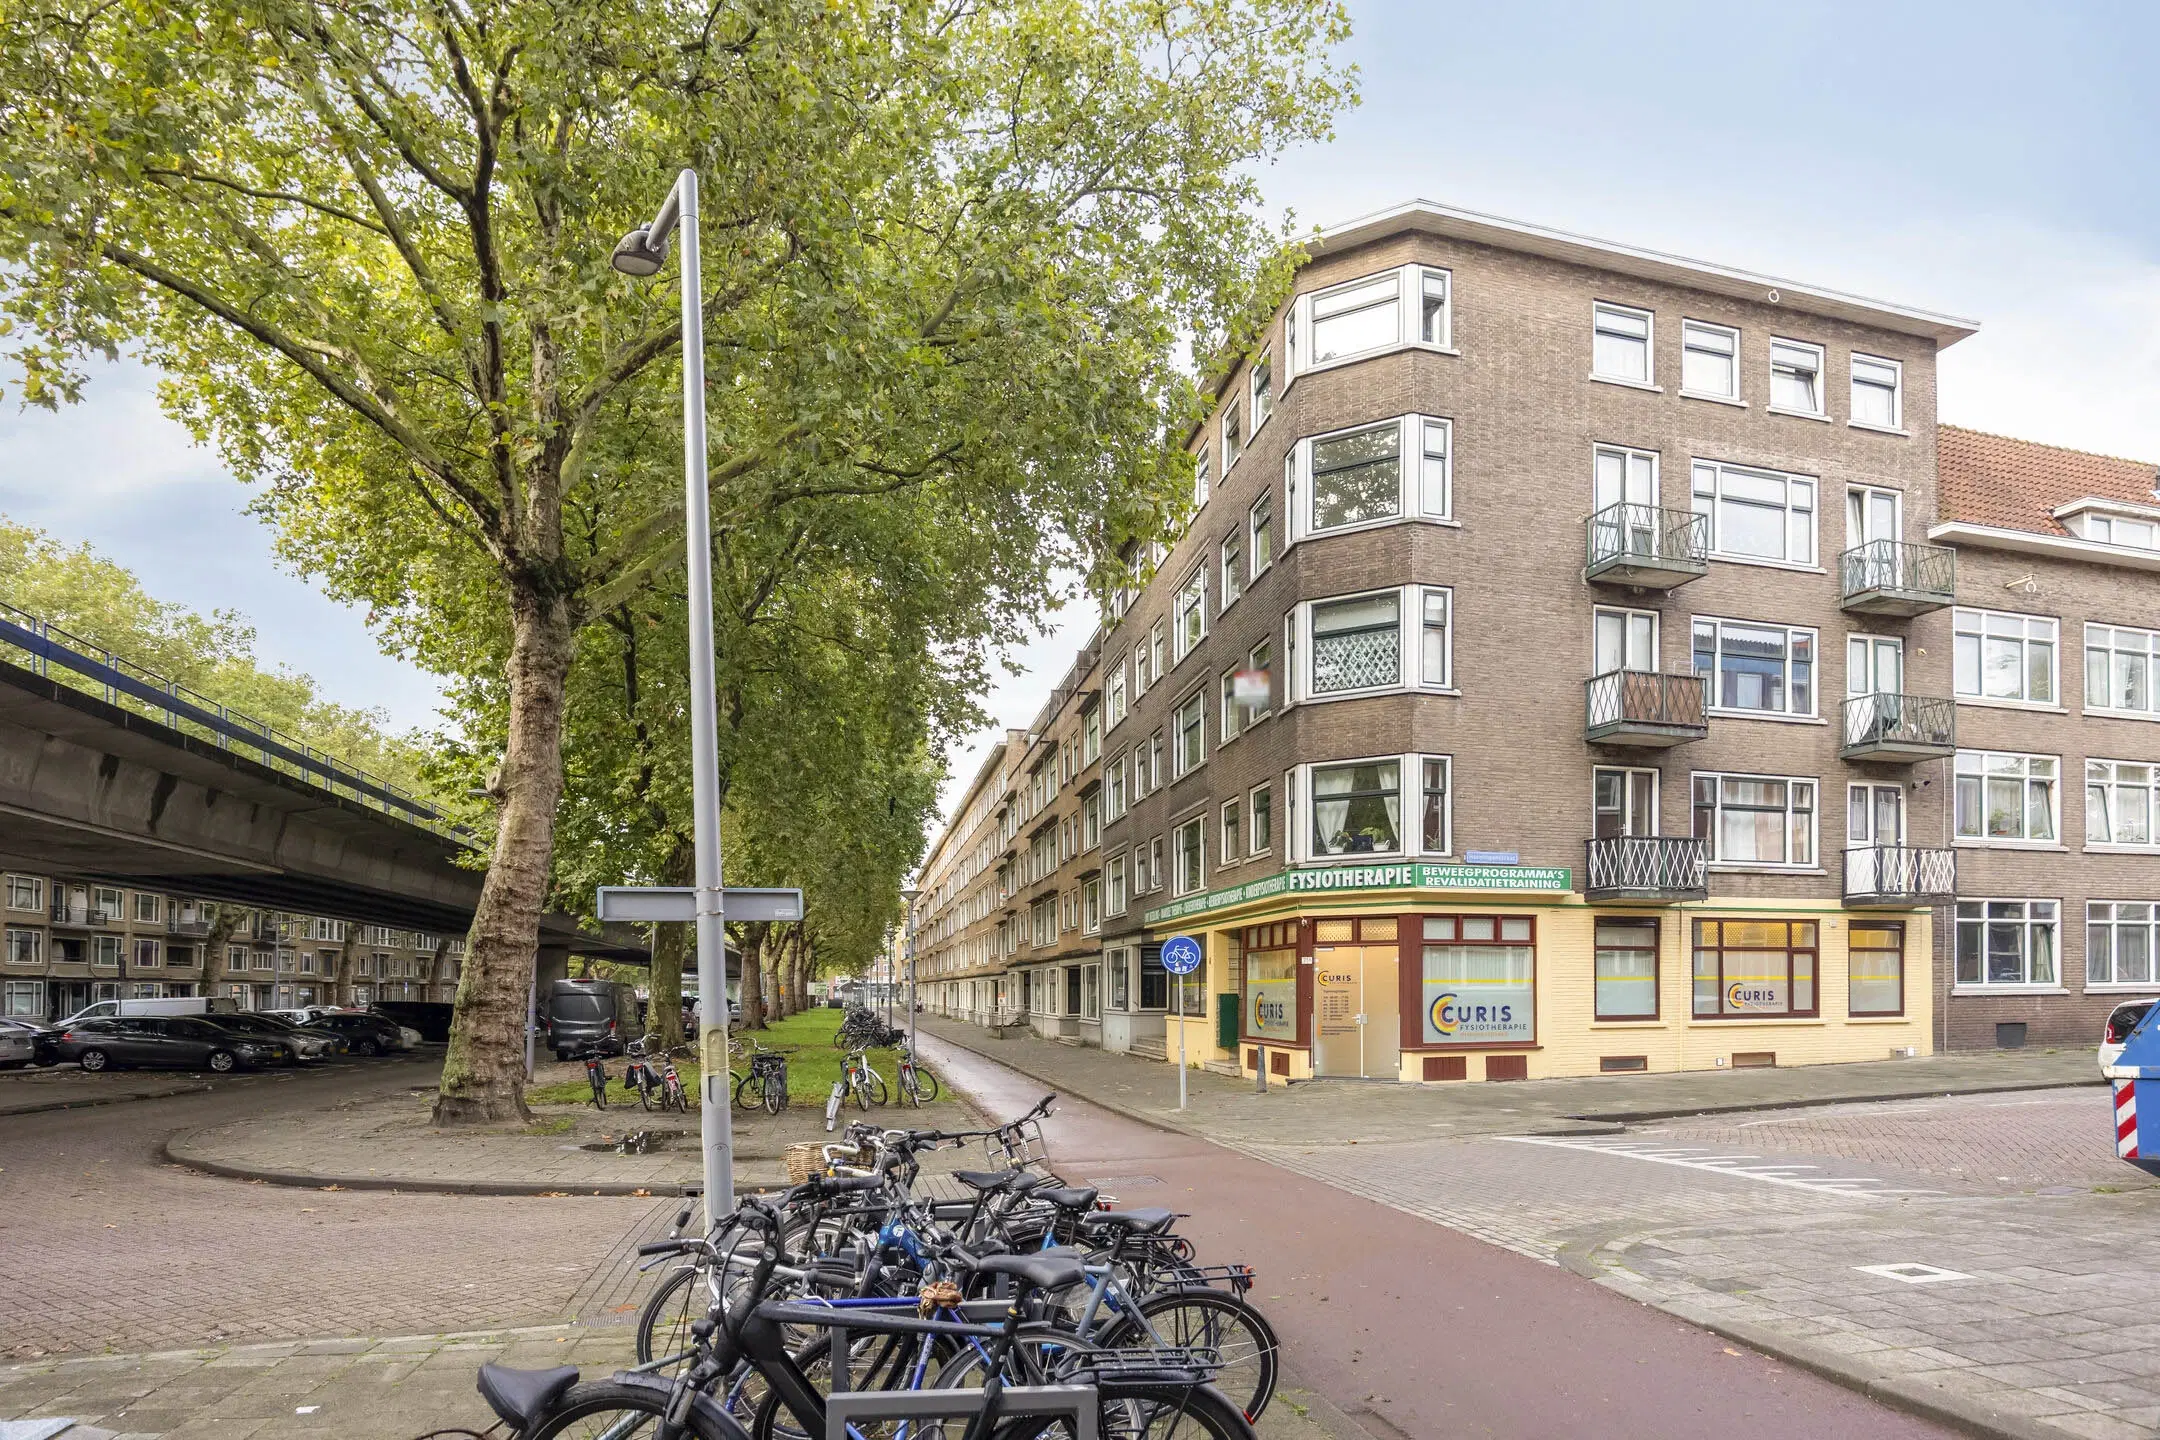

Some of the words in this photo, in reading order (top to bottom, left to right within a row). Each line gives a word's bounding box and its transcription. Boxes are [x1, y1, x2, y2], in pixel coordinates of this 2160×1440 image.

[1289, 866, 1412, 890] FYSIOTHERAPIE
[1422, 866, 1565, 879] BEWEEGPROGRAMMA'S
[1425, 877, 1561, 889] REVALIDATIETRAINING
[1734, 990, 1775, 1001] CURIS
[1441, 1005, 1512, 1023] CURIS
[1460, 1023, 1527, 1031] FYSIOTHERAPIE
